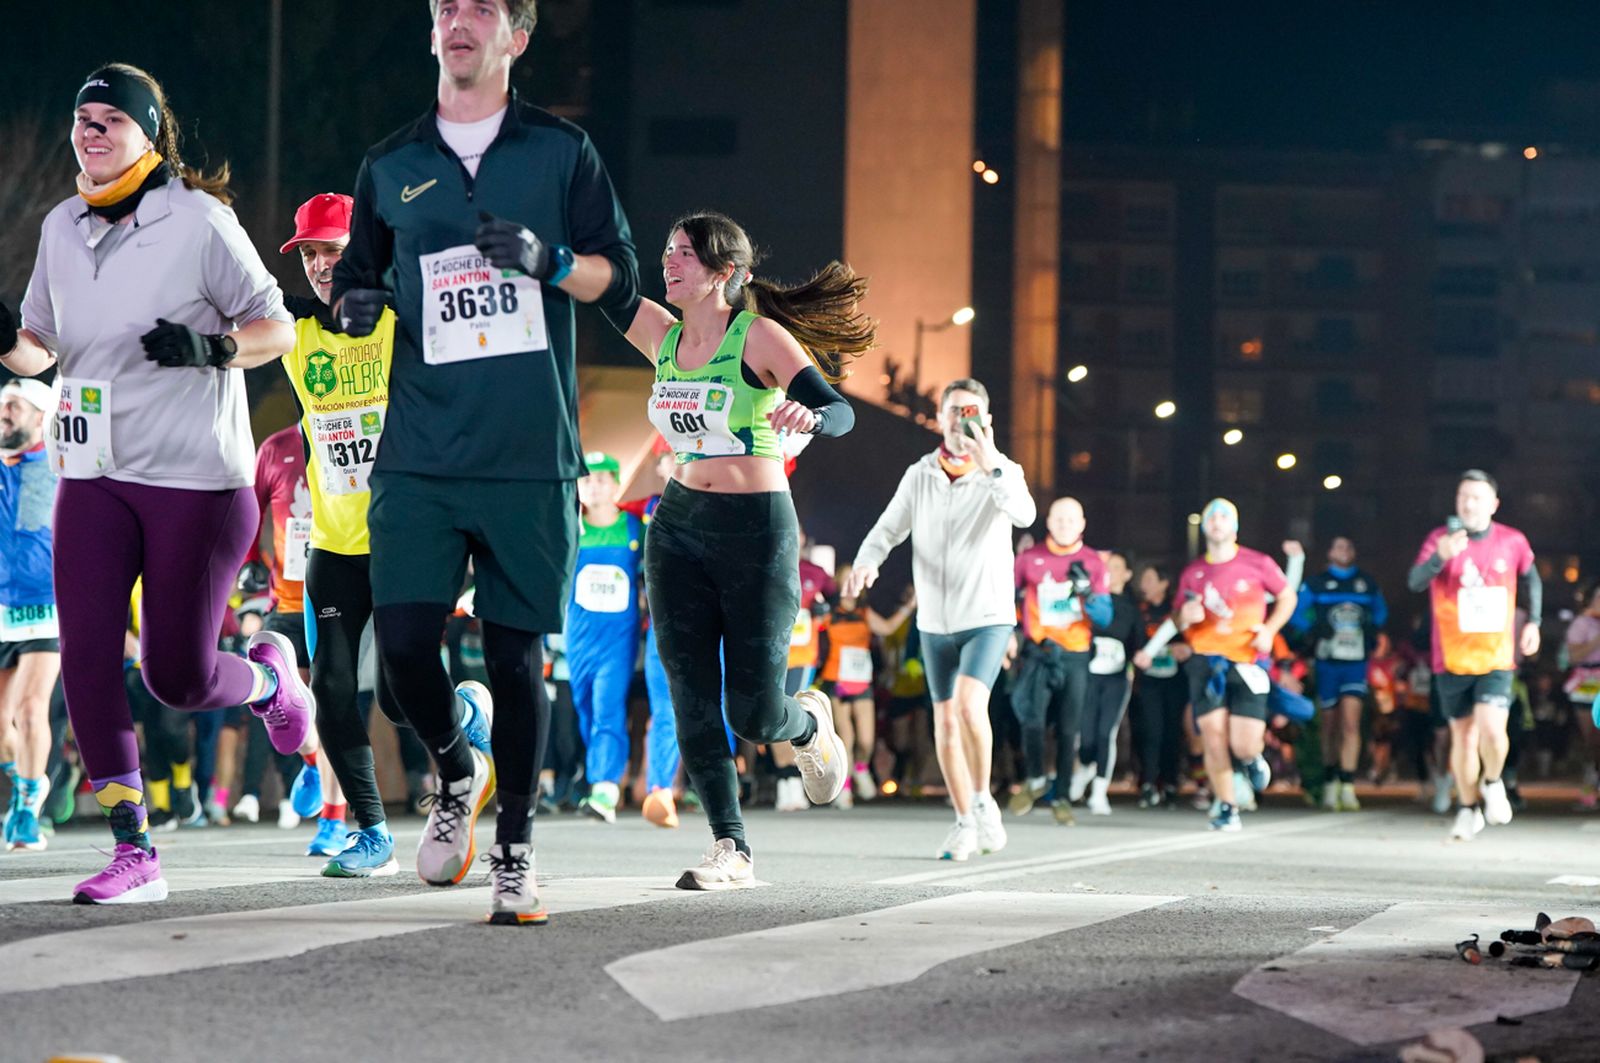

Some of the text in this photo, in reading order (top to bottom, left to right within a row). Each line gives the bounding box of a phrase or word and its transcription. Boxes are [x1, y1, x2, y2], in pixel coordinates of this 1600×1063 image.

[441, 260, 472, 274] NOCHE
[475, 257, 488, 269] DE
[432, 267, 491, 290] SAN ANTÓN
[439, 282, 519, 323] 3638
[61, 390, 72, 399] DE
[665, 391, 700, 400] NOCHE DE
[656, 401, 671, 410] SAN
[671, 399, 699, 410] ANTÓN
[343, 419, 353, 429] DE
[669, 411, 711, 434] 601
[328, 428, 355, 442] ANTÓN
[327, 438, 375, 467] 4312
[9, 604, 53, 624] 13081
